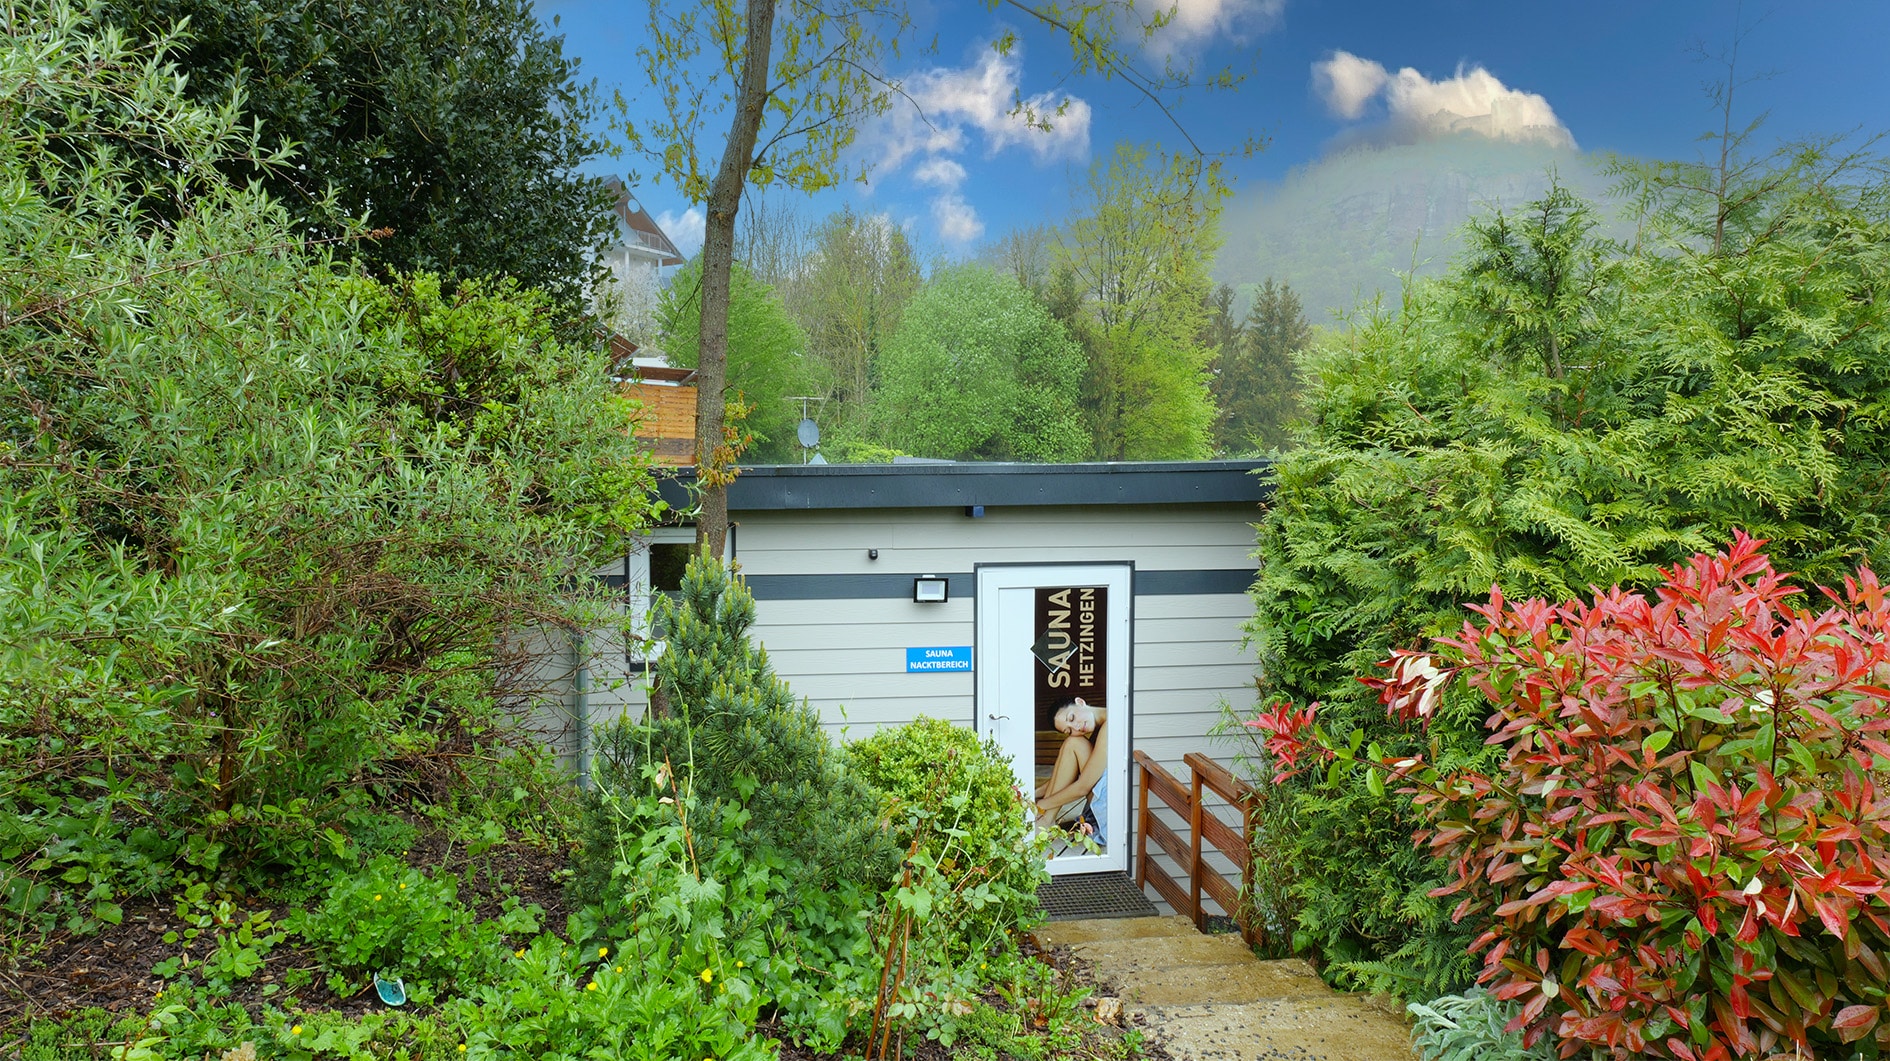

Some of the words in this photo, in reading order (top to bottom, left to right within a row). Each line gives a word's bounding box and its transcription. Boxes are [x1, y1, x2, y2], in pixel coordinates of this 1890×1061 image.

[925, 650, 953, 658] SAUNA
[1048, 589, 1071, 688] SAUNA
[1079, 588, 1095, 687] HETZINGEN
[910, 661, 969, 669] NACKTBEREICH
